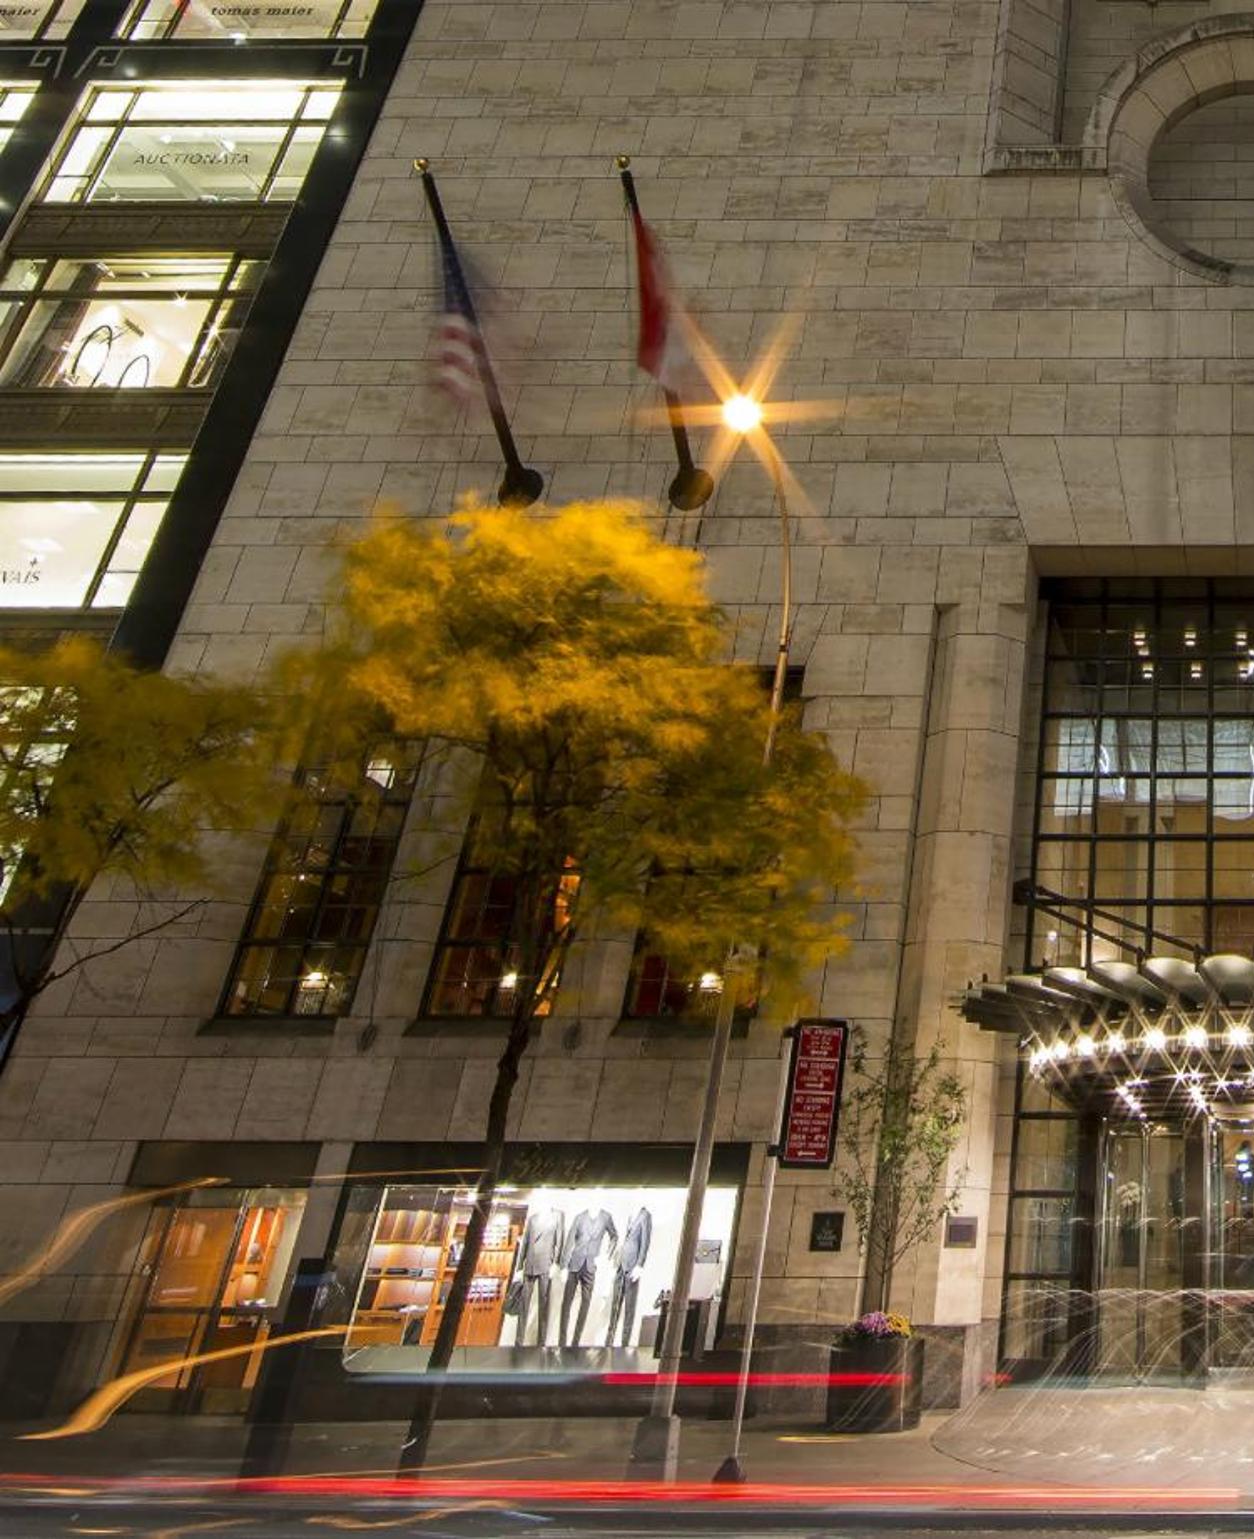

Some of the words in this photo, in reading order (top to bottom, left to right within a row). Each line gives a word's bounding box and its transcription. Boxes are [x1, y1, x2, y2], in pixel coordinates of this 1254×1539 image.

[211, 7, 260, 16] tomas
[266, 7, 314, 16] maier
[133, 152, 249, 165] AUCTIONATA
